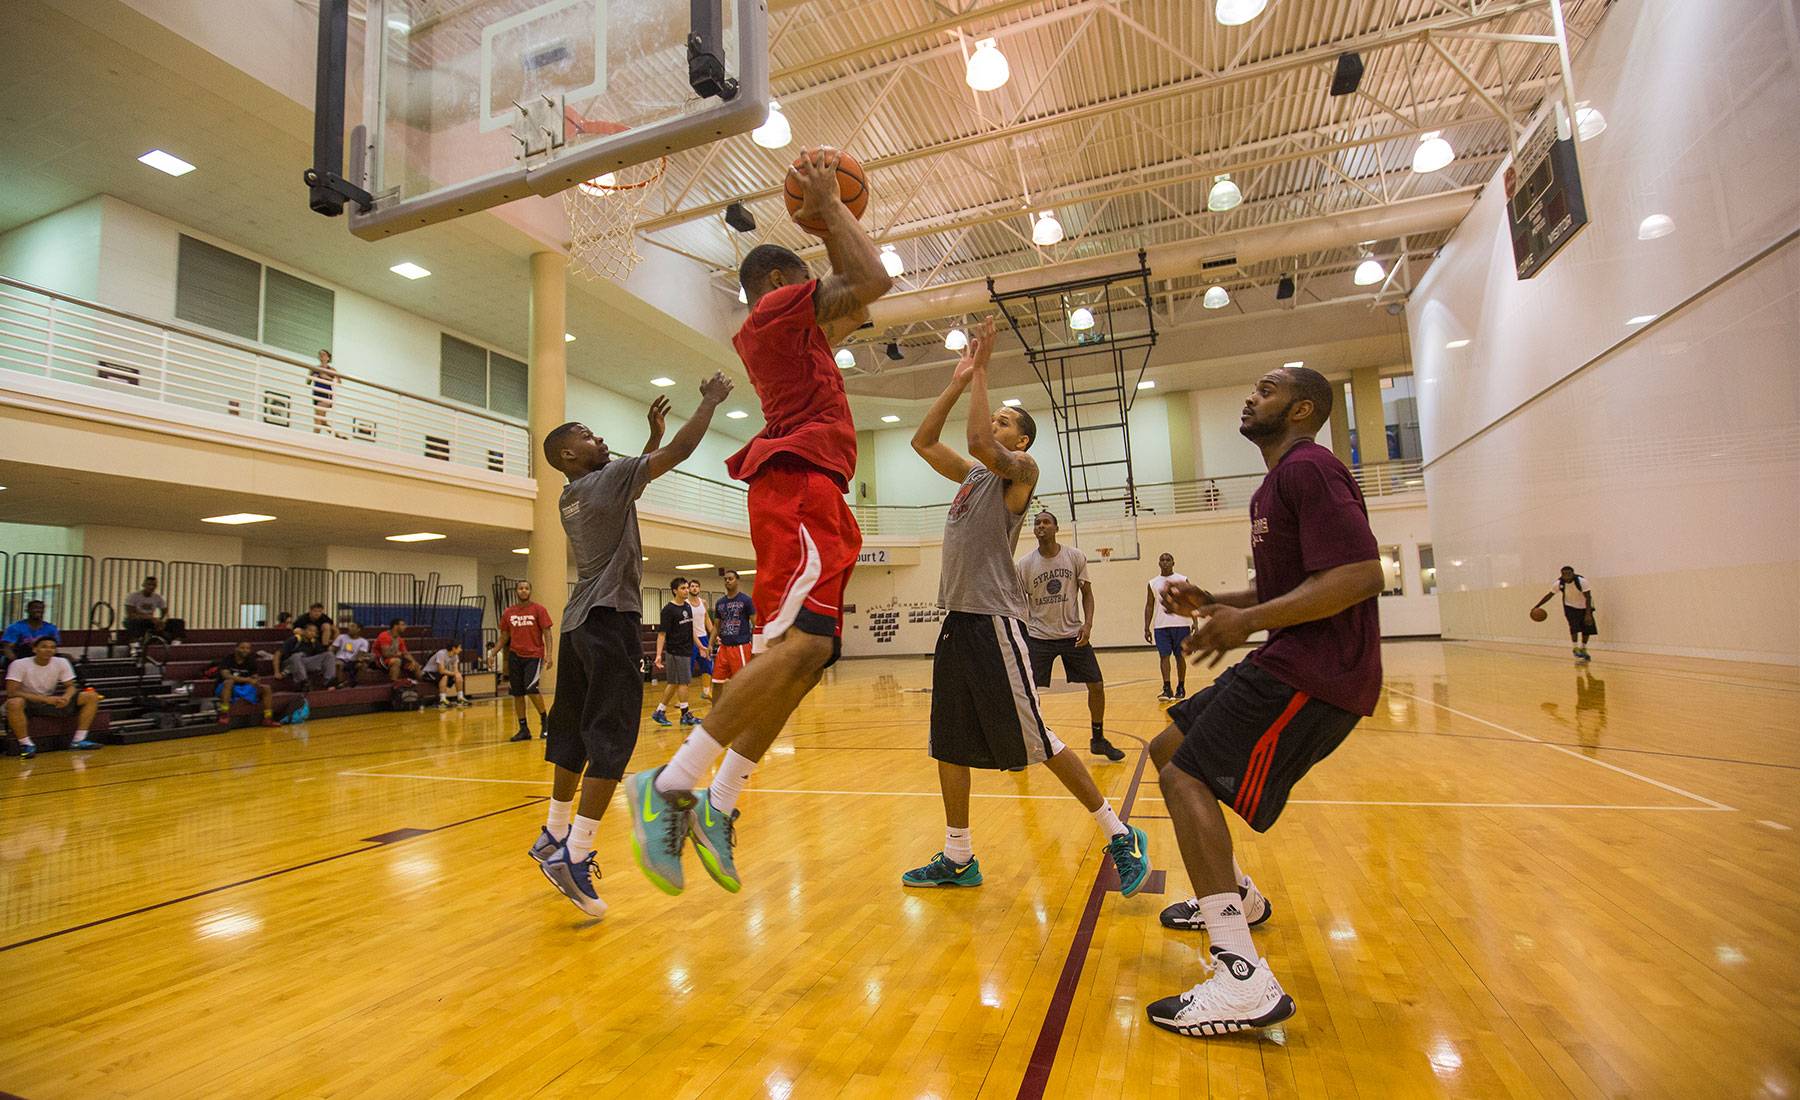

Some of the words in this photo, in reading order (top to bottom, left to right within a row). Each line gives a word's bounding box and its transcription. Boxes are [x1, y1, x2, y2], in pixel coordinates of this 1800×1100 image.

[1547, 213, 1573, 244] VISITOR
[878, 551, 885, 562] 2
[1034, 594, 1069, 605] BASKETBL
